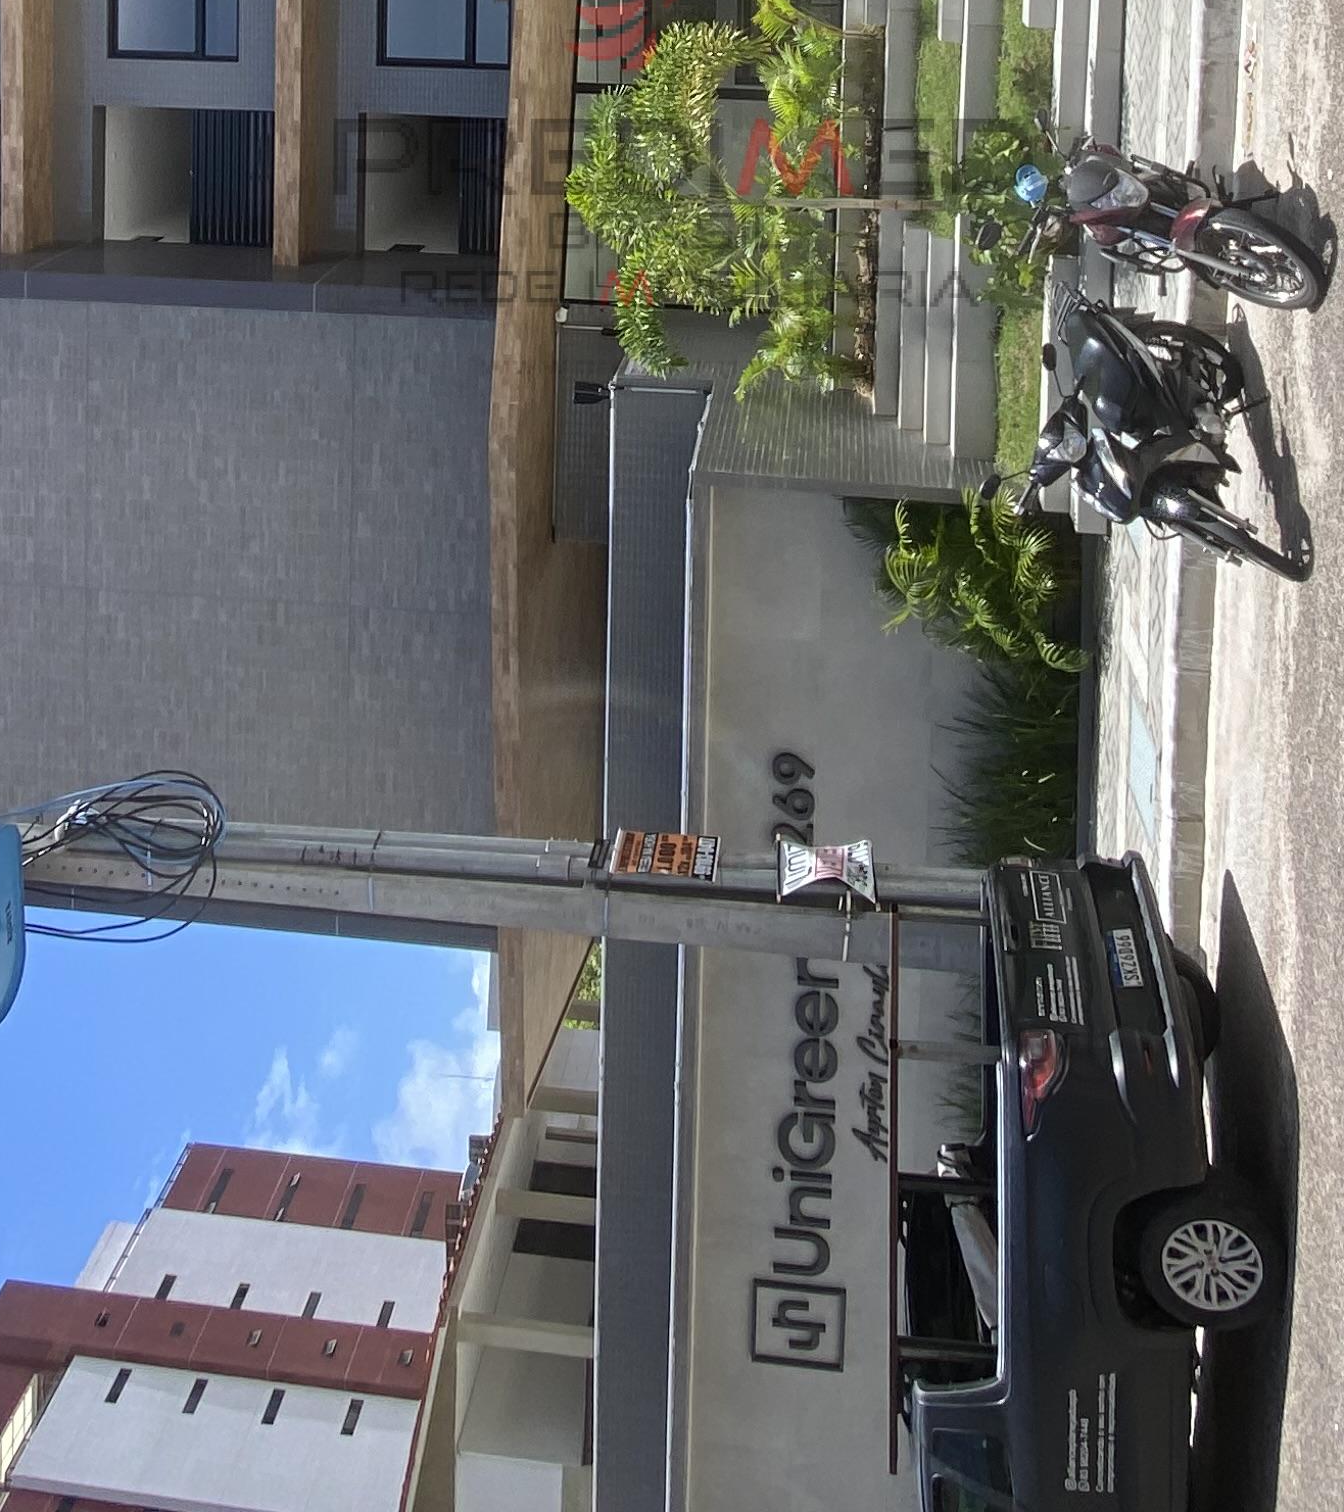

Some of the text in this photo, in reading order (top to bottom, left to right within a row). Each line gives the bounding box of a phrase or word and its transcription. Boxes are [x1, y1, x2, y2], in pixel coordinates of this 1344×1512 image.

[771, 752, 815, 848] 269
[1038, 874, 1056, 918] ALLIANCE
[852, 1072, 889, 1163] Ayrton
